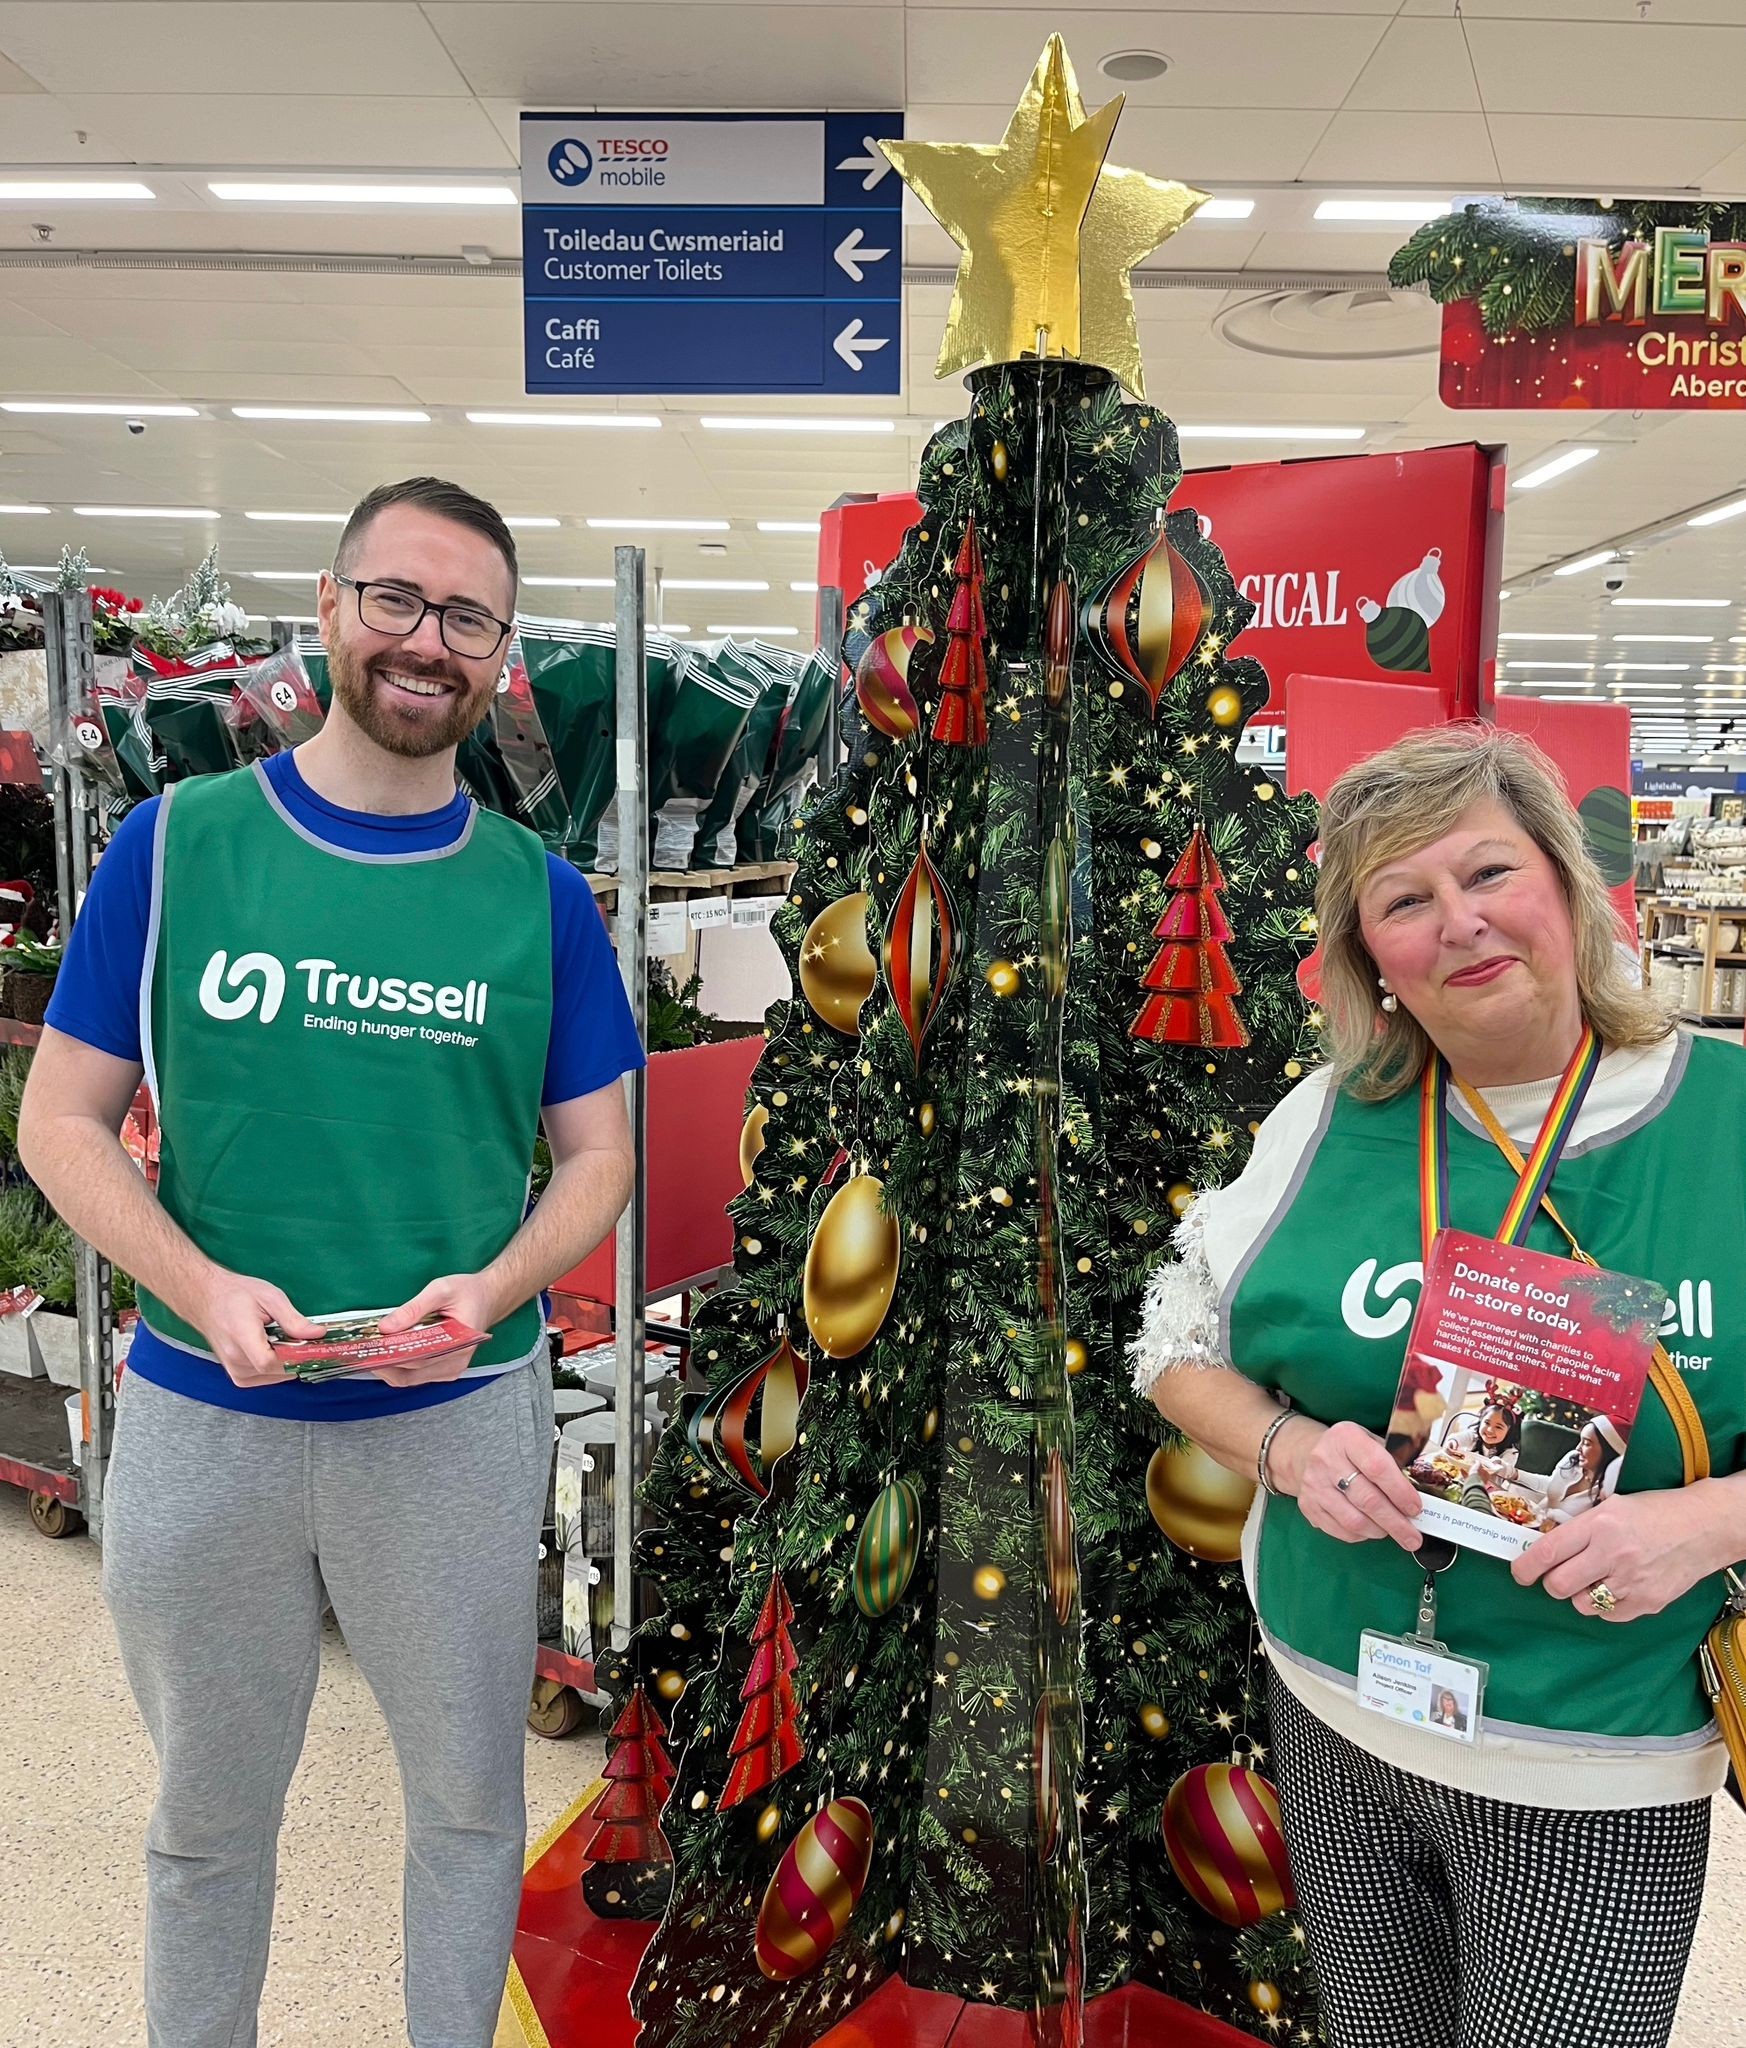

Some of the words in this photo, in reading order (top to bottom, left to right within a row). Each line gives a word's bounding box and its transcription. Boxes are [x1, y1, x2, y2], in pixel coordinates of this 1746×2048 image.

[597, 139, 669, 155] TESCO
[600, 167, 666, 186] mobile
[544, 228, 644, 252] Toiledau
[648, 229, 784, 252] Cwsmeriaid
[544, 259, 650, 281] Customer
[654, 259, 723, 281] Toilets
[1575, 227, 1746, 327] MER
[545, 318, 600, 341] Caffi
[545, 346, 595, 369] Café
[1637, 331, 1746, 367] Christ
[1239, 570, 1348, 629] GICAL
[276, 687, 292, 706] £4
[81, 729, 98, 741] £4
[295, 958, 488, 1025] Trussell
[303, 1014, 357, 1035] Ending
[361, 1019, 416, 1040] hunger
[419, 1025, 479, 1048] together
[1454, 1262, 1520, 1294] Donate
[1524, 1283, 1570, 1309] food
[1448, 1282, 1523, 1317] in-store
[1527, 1305, 1582, 1336] today.
[1442, 1308, 1469, 1323] We've
[1470, 1318, 1518, 1337] partnered
[1518, 1332, 1539, 1344] with
[1540, 1339, 1581, 1357] charities
[1583, 1351, 1594, 1361] to
[1433, 1339, 1462, 1354] makes
[1463, 1347, 1471, 1357] it
[1472, 1350, 1521, 1372] Christmas.
[1436, 1328, 1477, 1348] hardship.
[1480, 1341, 1514, 1361] Helping
[1550, 1363, 1577, 1378] that's
[1579, 1372, 1602, 1386] what
[1439, 1320, 1470, 1334] collect
[1471, 1329, 1513, 1347] essential
[1513, 1340, 1539, 1355] items
[1541, 1348, 1556, 1360] for
[1556, 1355, 1590, 1371] people
[1592, 1364, 1621, 1382] facing
[1668, 1350, 1713, 1371] ther
[1443, 1513, 1450, 1522] in
[1451, 1518, 1499, 1539] partnership
[1500, 1533, 1518, 1545] with
[1374, 1648, 1411, 1669] Cynon
[1414, 1660, 1433, 1674] Taf
